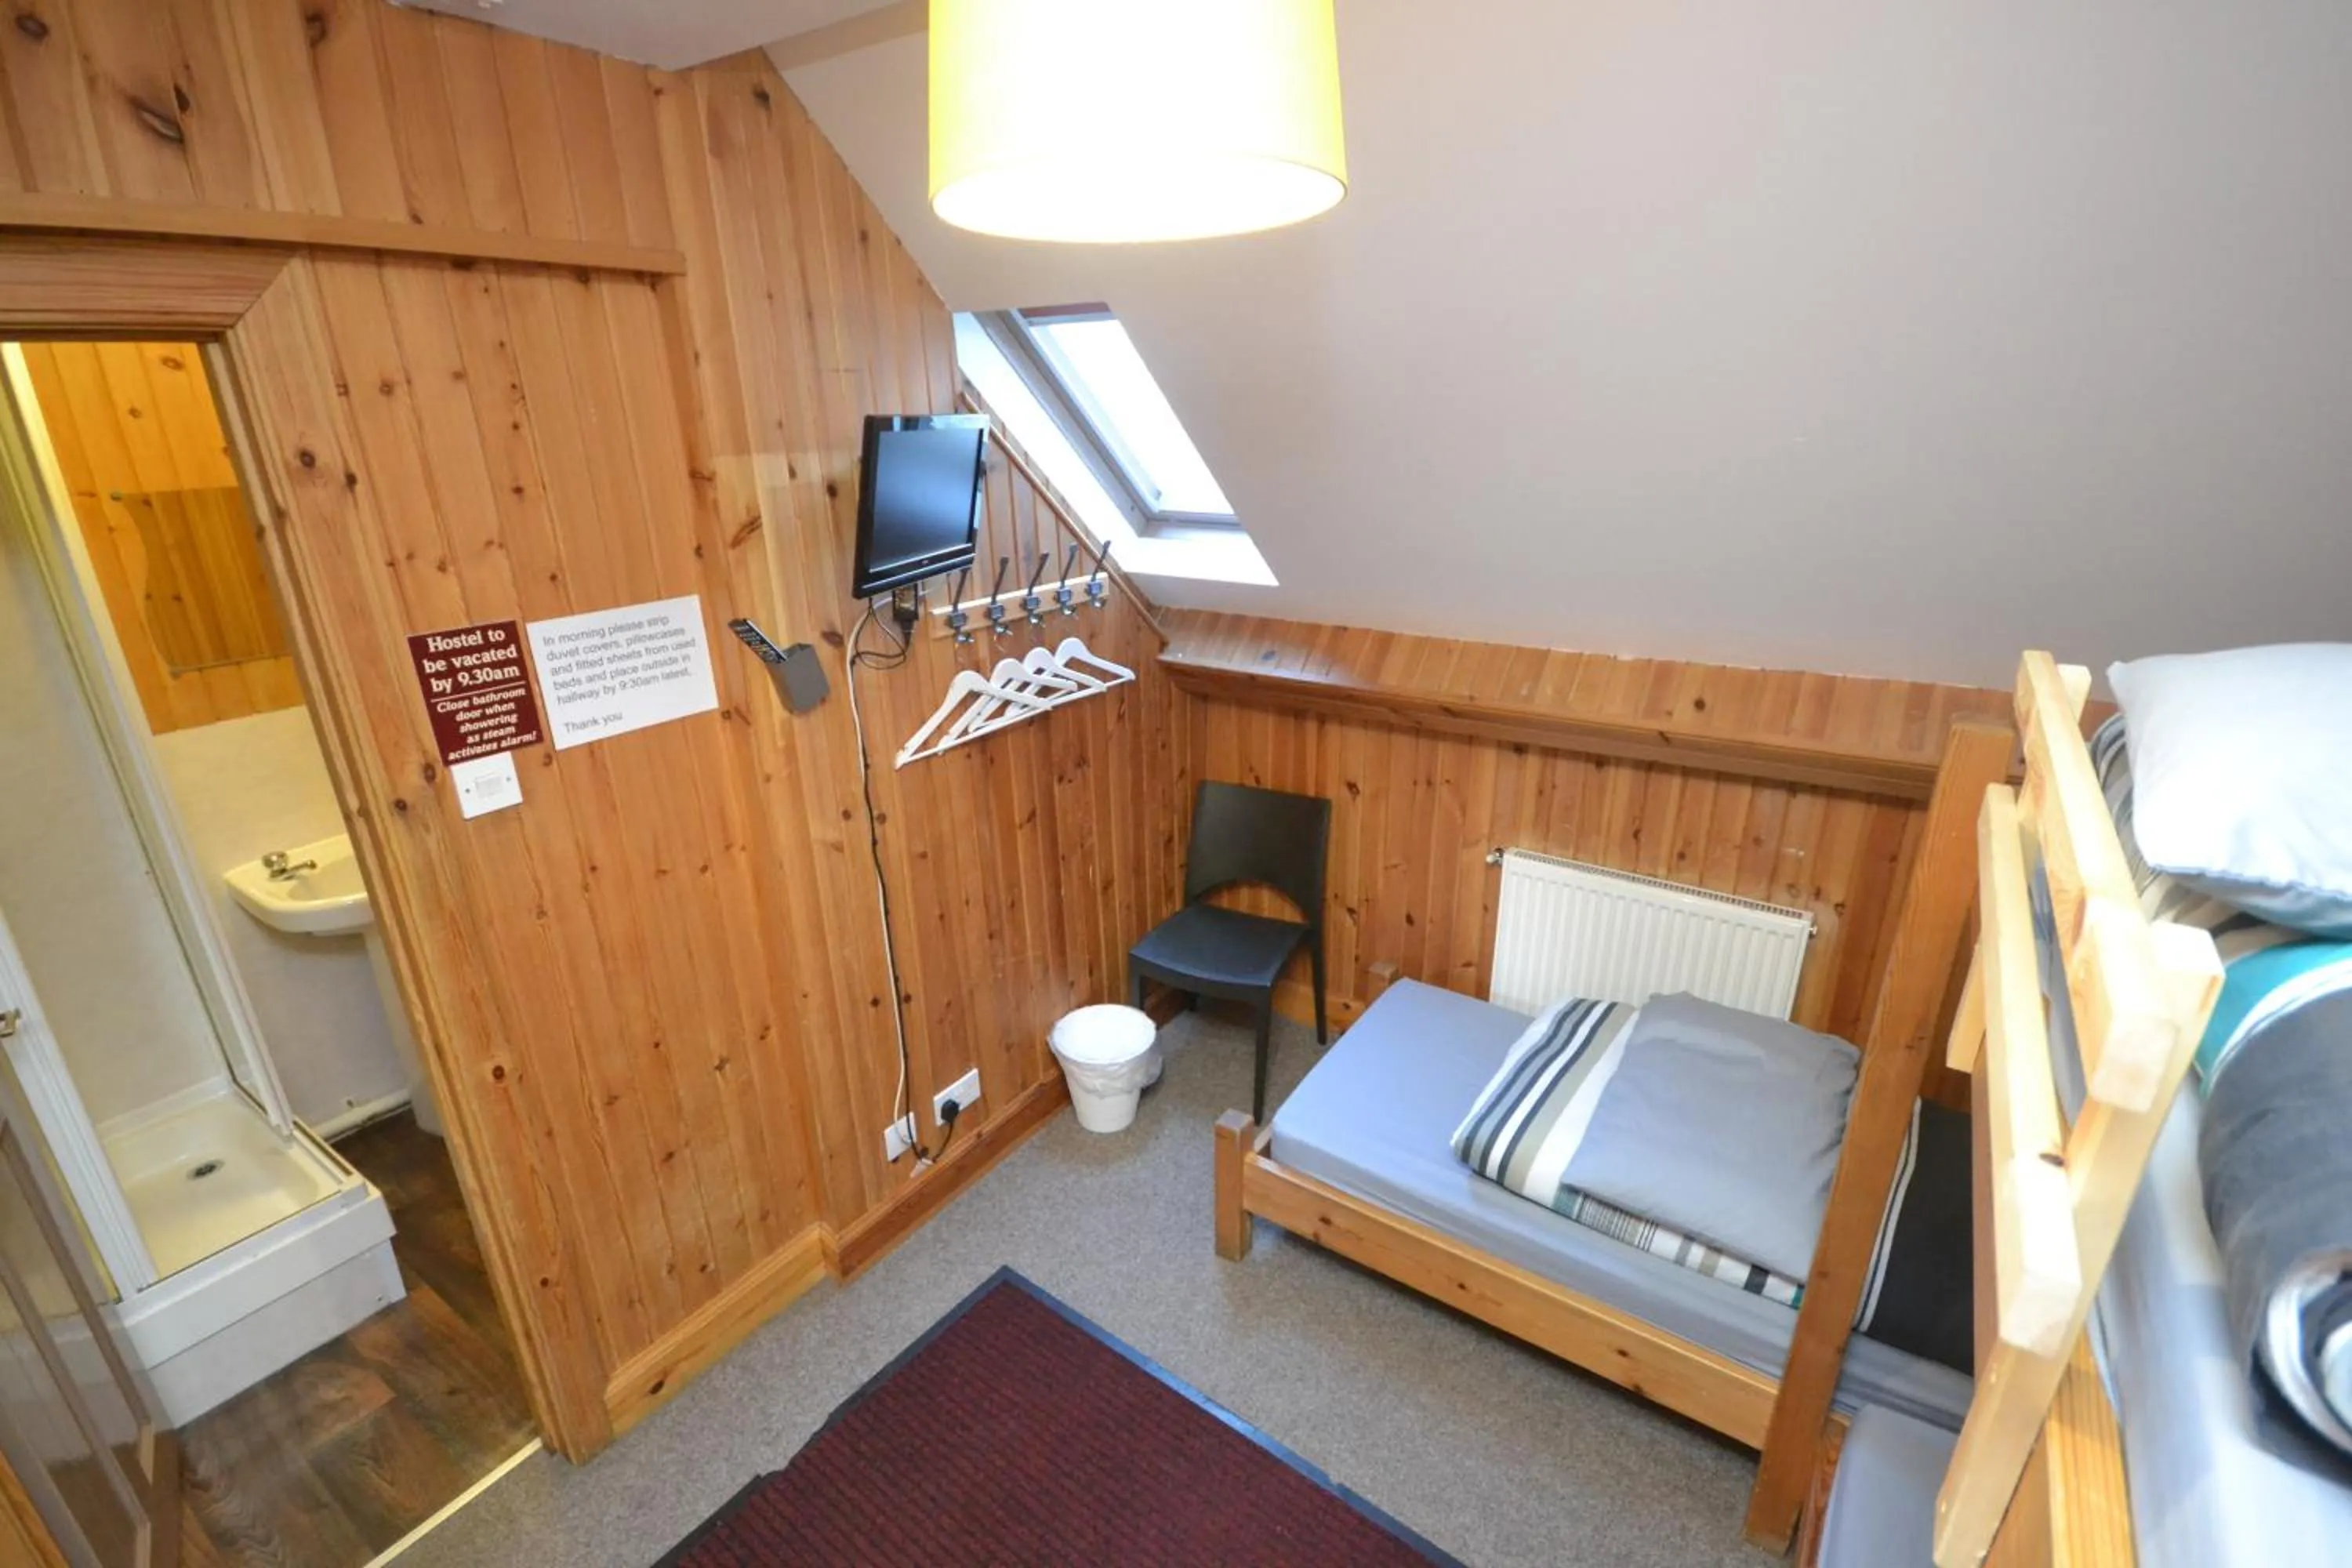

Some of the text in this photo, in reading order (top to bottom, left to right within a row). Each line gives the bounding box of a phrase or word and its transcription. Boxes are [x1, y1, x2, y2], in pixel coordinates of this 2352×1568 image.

[426, 629, 506, 652] Hostel to
[543, 615, 670, 648] In morning please strip
[546, 647, 579, 662] duvet
[626, 627, 686, 646] pillowcases
[422, 644, 518, 673] be vacated
[551, 638, 696, 677] and fitted sheets from used
[430, 666, 520, 694] by 9.30am
[554, 653, 691, 691] beds and place outside in
[437, 688, 526, 713] Close bathroom
[557, 688, 601, 706] hallway
[603, 684, 617, 697] by
[456, 702, 515, 721] door when
[459, 713, 518, 733] showering
[564, 711, 623, 734] Thank you
[448, 730, 537, 760] activates alarm!
[466, 726, 516, 744] as steam
